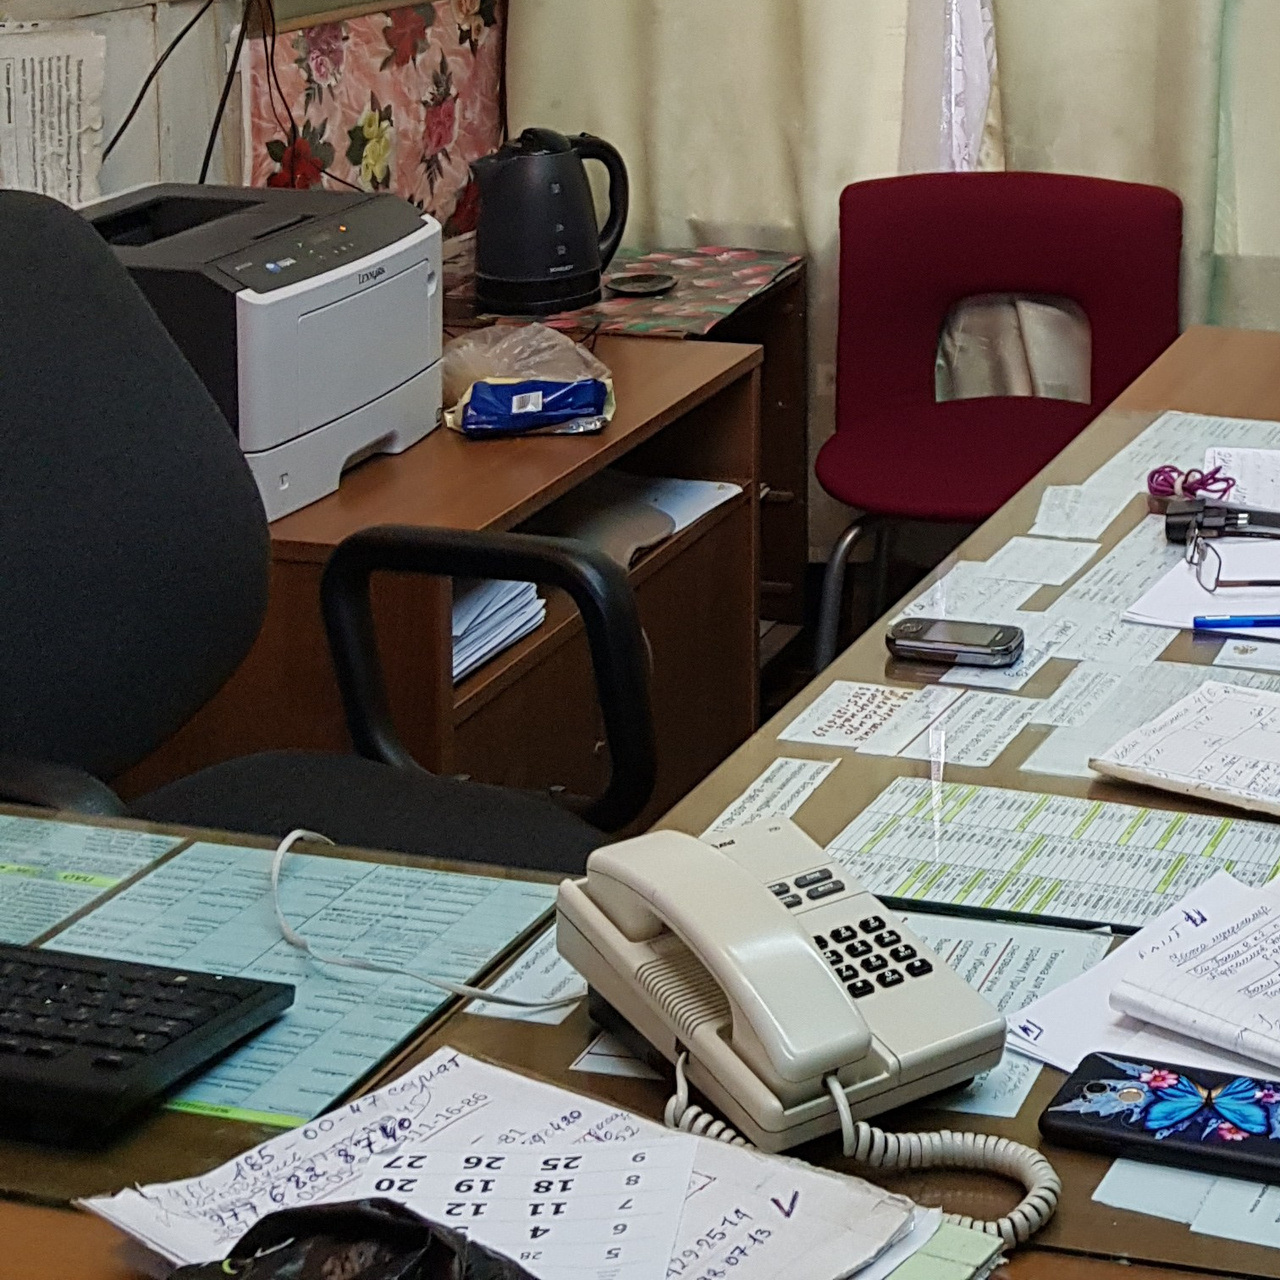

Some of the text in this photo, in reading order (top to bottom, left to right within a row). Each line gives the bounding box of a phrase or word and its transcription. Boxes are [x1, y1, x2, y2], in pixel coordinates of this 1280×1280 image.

[383, 1155, 427, 1169] 27
[463, 1156, 505, 1170] 26
[541, 1156, 582, 1170] 25
[632, 1152, 646, 1163] 9
[374, 1178, 418, 1192] 20
[454, 1179, 495, 1193] 19
[533, 1178, 574, 1193] 18
[625, 1175, 640, 1186] 8
[445, 1203, 488, 1216] 12
[528, 1202, 567, 1216] 11
[618, 1199, 633, 1210] 7
[529, 1226, 550, 1239] 4
[612, 1223, 628, 1235] 6
[605, 1248, 622, 1259] 5
